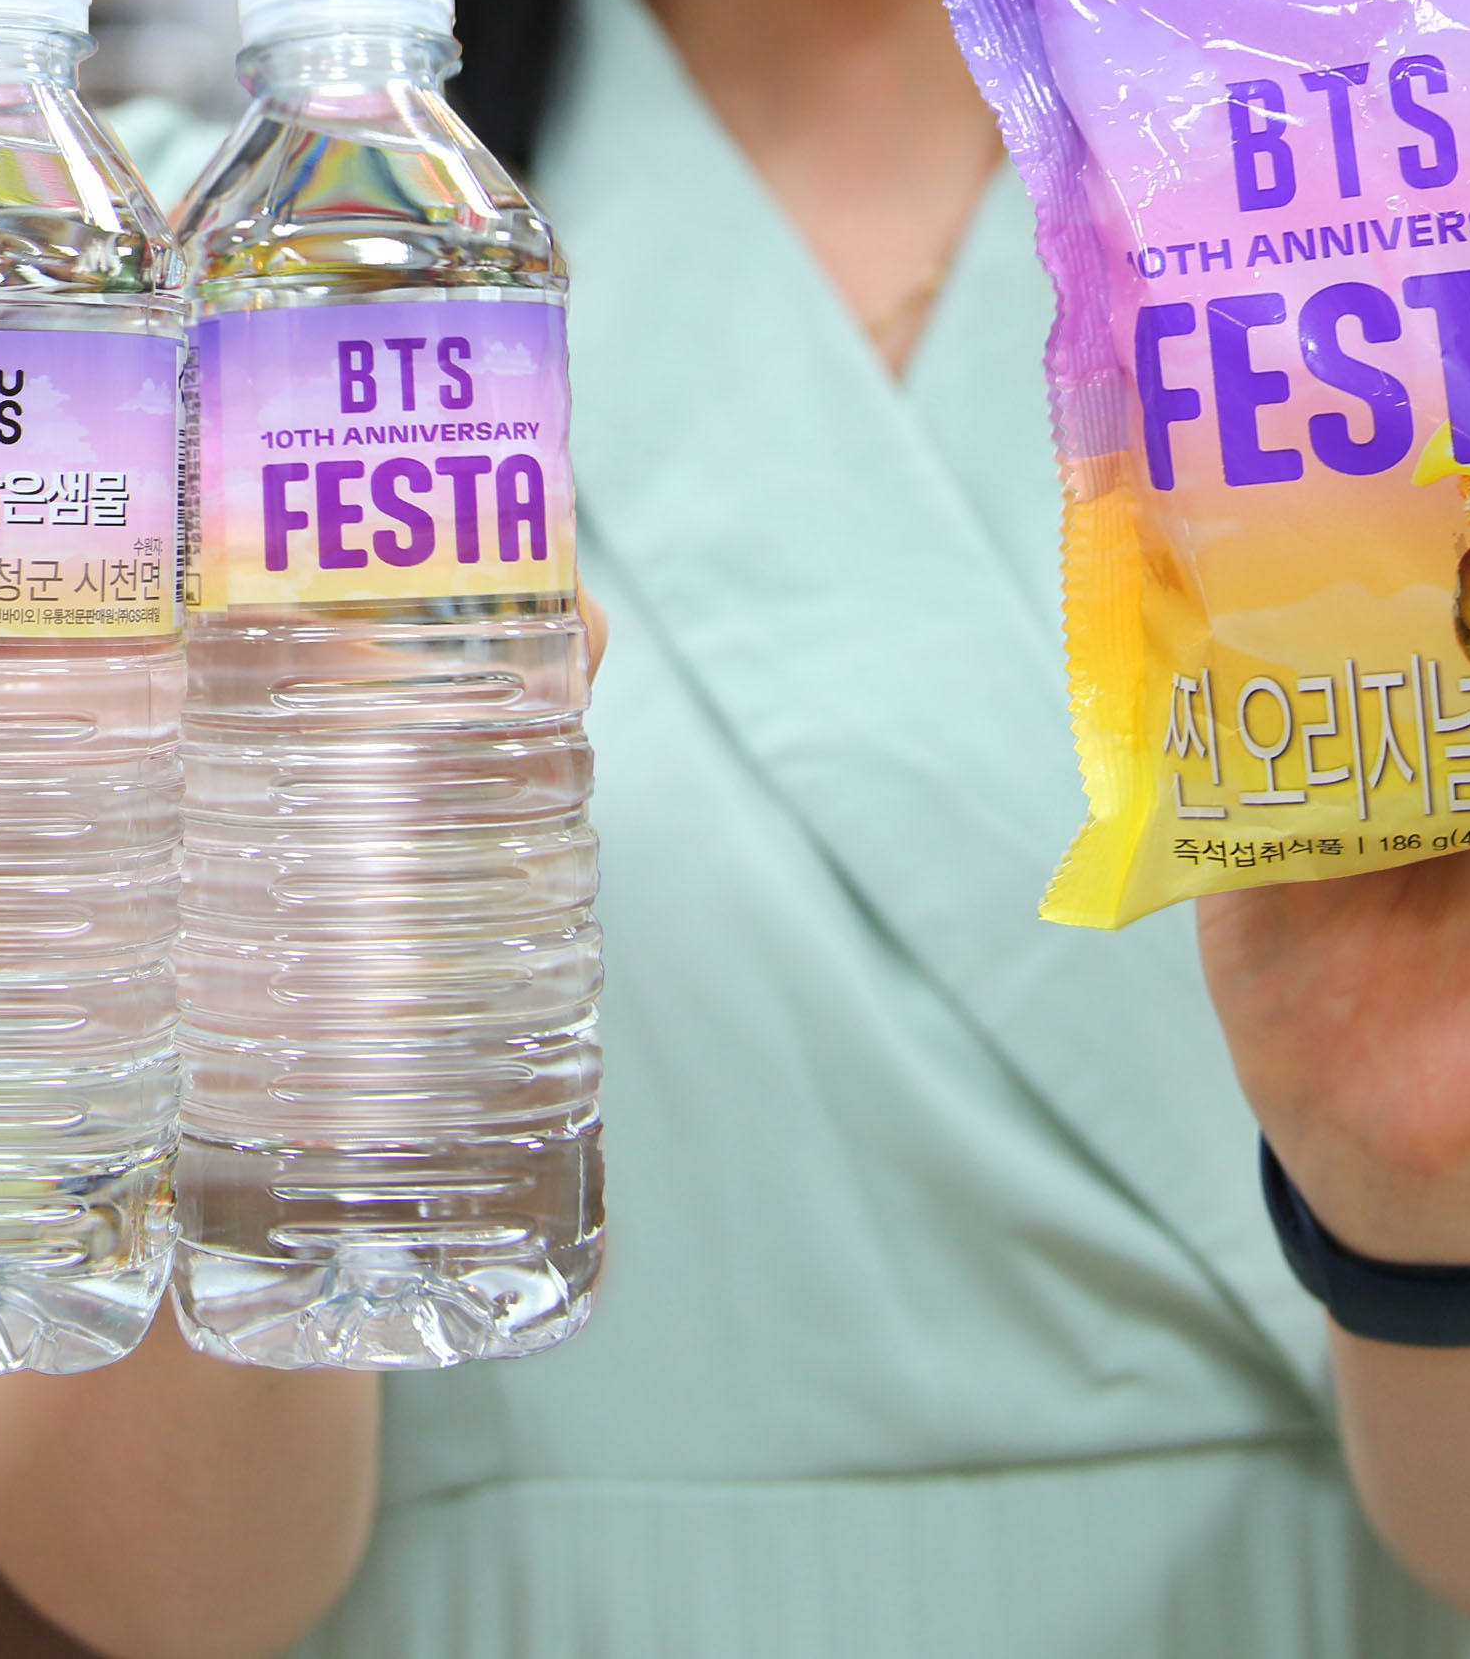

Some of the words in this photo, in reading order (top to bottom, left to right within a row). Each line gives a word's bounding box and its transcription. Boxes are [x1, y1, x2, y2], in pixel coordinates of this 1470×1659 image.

[1227, 54, 1459, 212] BTS
[338, 336, 474, 414] BTS
[260, 427, 335, 449] 10TH
[343, 421, 540, 446] ANNIVERSARY
[262, 453, 548, 571] FESTA
[74, 558, 161, 602] 시천면
[1172, 837, 1344, 869] 즉석섭취식품
[1379, 834, 1422, 852] 186
